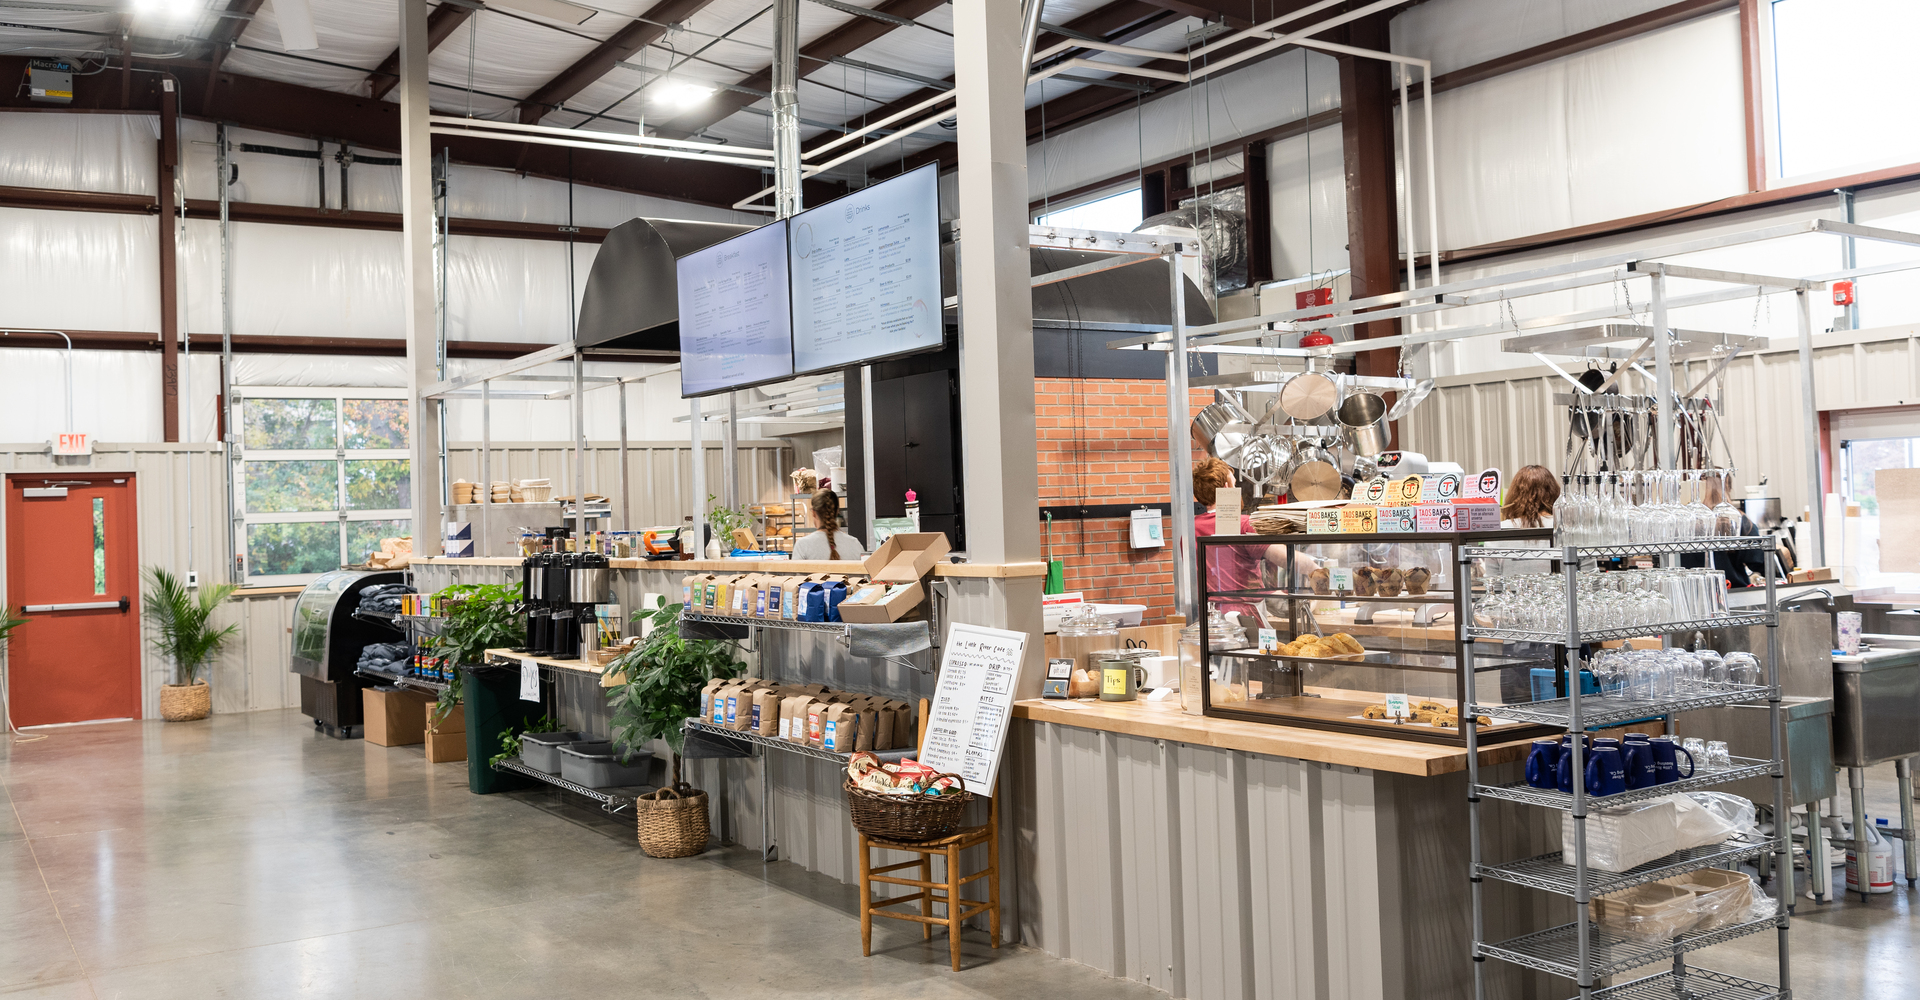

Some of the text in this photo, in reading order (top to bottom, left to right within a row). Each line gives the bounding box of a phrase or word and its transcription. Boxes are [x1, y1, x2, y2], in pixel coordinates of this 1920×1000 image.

[33, 60, 70, 70] MacroAir
[856, 204, 871, 215] Drinks
[59, 434, 87, 453] EXIT
[1321, 511, 1337, 519] BAKES
[1356, 510, 1372, 518] BAKES
[1393, 509, 1410, 517] BAKES
[1432, 508, 1450, 516] BAKES
[1105, 675, 1121, 686] Tips
